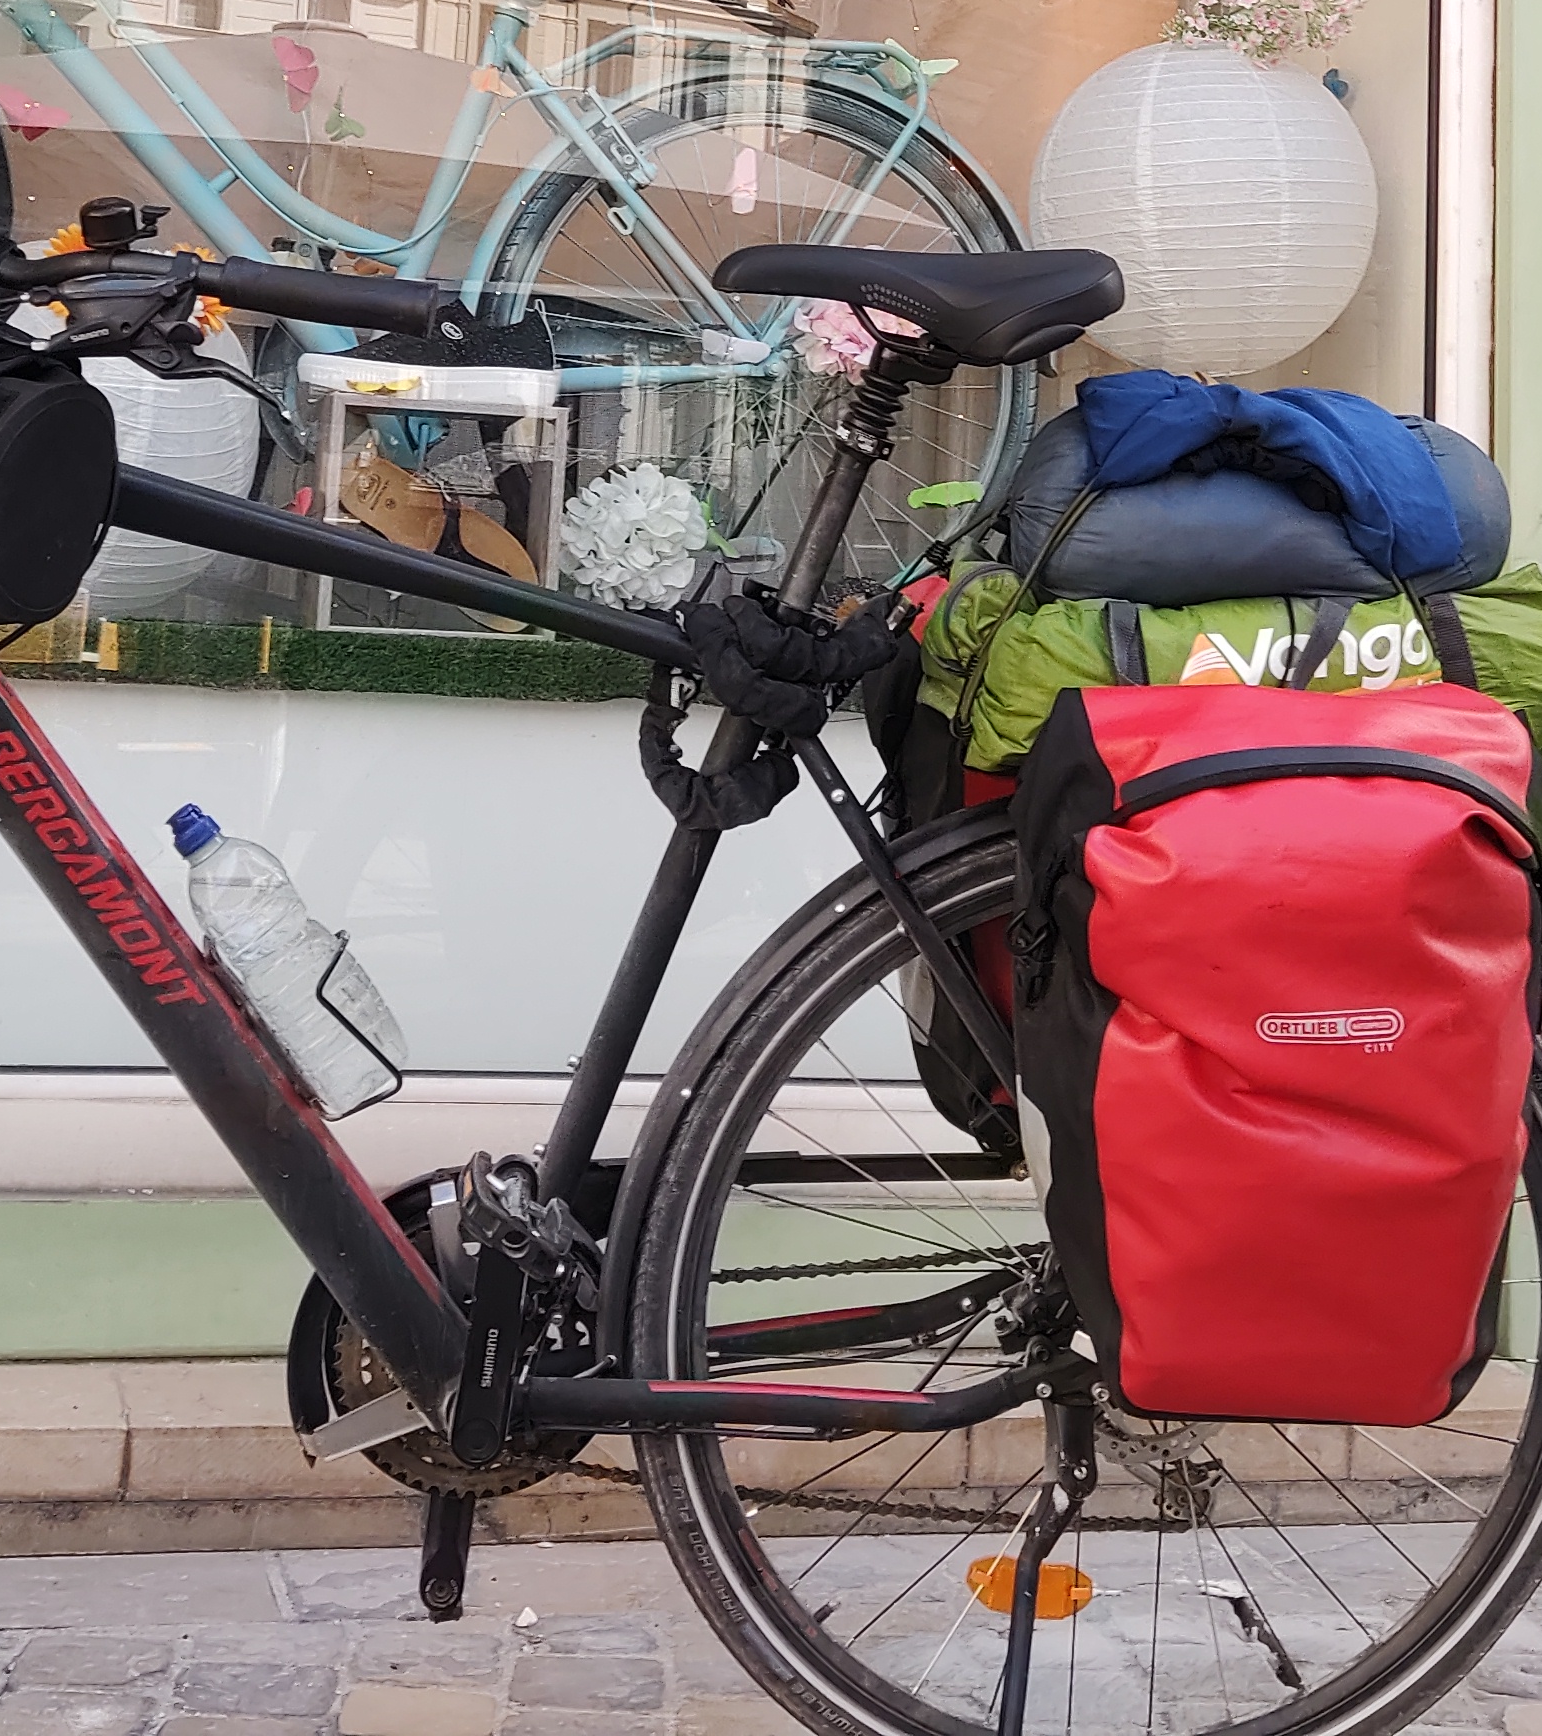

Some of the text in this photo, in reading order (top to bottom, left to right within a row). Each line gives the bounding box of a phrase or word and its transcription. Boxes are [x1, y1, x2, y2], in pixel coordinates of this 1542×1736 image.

[1267, 1020, 1338, 1035] ORTLIEB
[1363, 1042, 1395, 1054] CITY
[479, 1328, 500, 1388] SHIMANO
[689, 1531, 745, 1623] MARATHON
[790, 1681, 867, 1736] HWALBE
